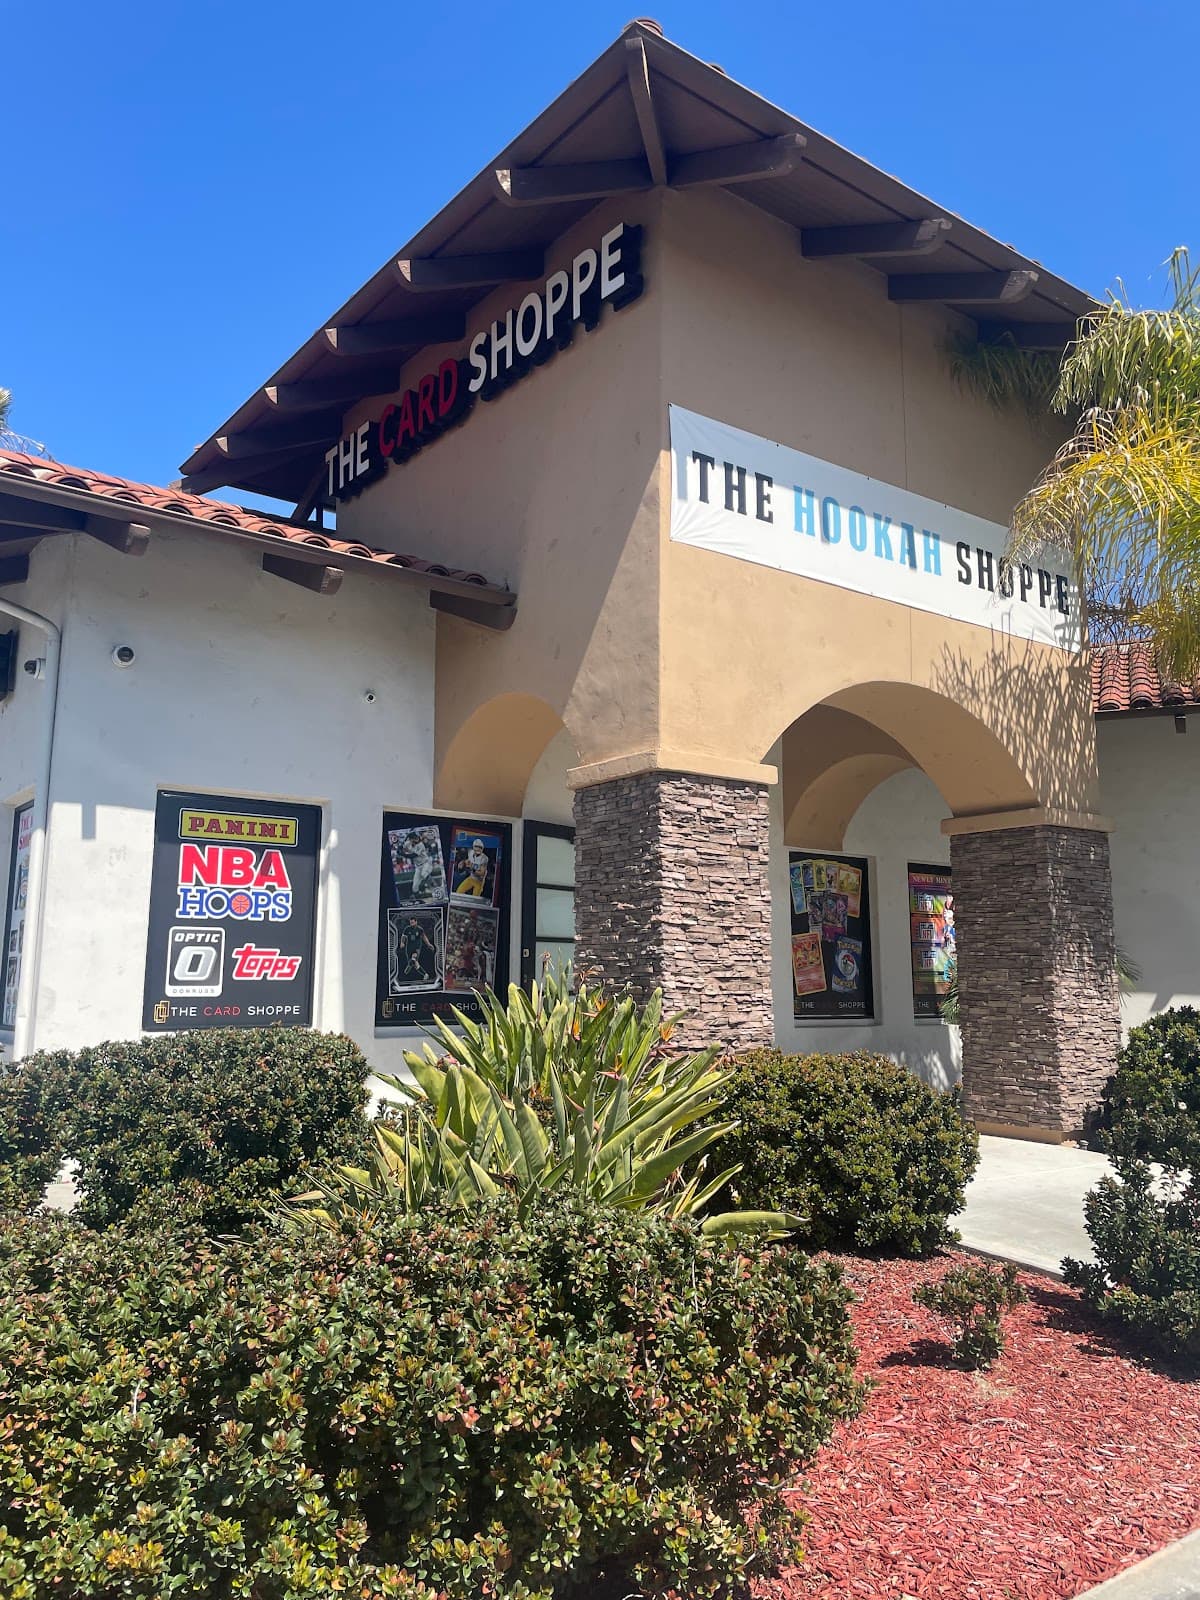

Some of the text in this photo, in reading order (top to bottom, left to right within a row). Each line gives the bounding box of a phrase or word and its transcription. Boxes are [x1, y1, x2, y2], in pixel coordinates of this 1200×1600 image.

[325, 222, 626, 497] THE CARD SHOPPE
[692, 450, 1070, 616] THE HOOKAH SHOPPE
[188, 815, 291, 839] PANINI
[179, 843, 291, 890] NBA
[177, 887, 292, 921] HOOPS
[174, 932, 221, 943] OPTIC
[171, 1005, 301, 1017] THE CARD SHOPPE
[395, 1003, 417, 1012] THE
[801, 1001, 866, 1009] THE SHOPPE
